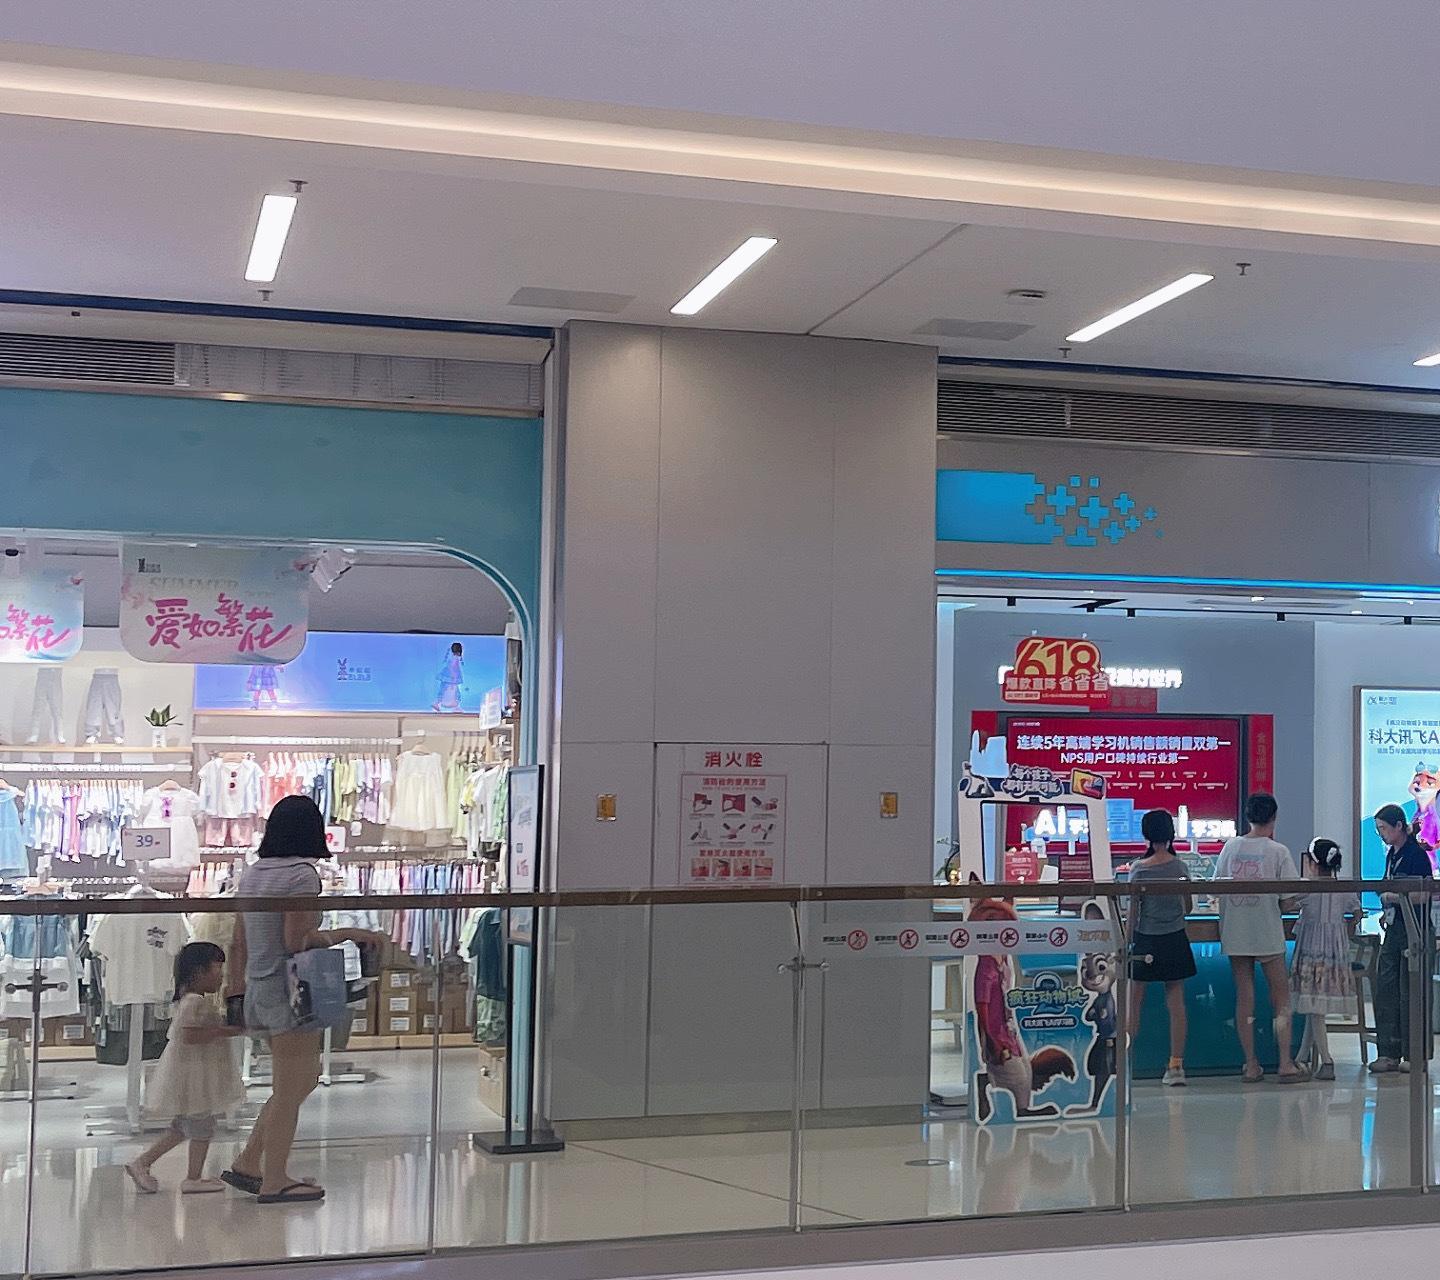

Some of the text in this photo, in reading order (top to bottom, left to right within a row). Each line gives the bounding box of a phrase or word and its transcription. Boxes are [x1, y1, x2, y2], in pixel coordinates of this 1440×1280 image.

[145, 593, 293, 652] 爱如繁花
[1013, 639, 1101, 676] 618
[705, 751, 763, 768] 消火栓
